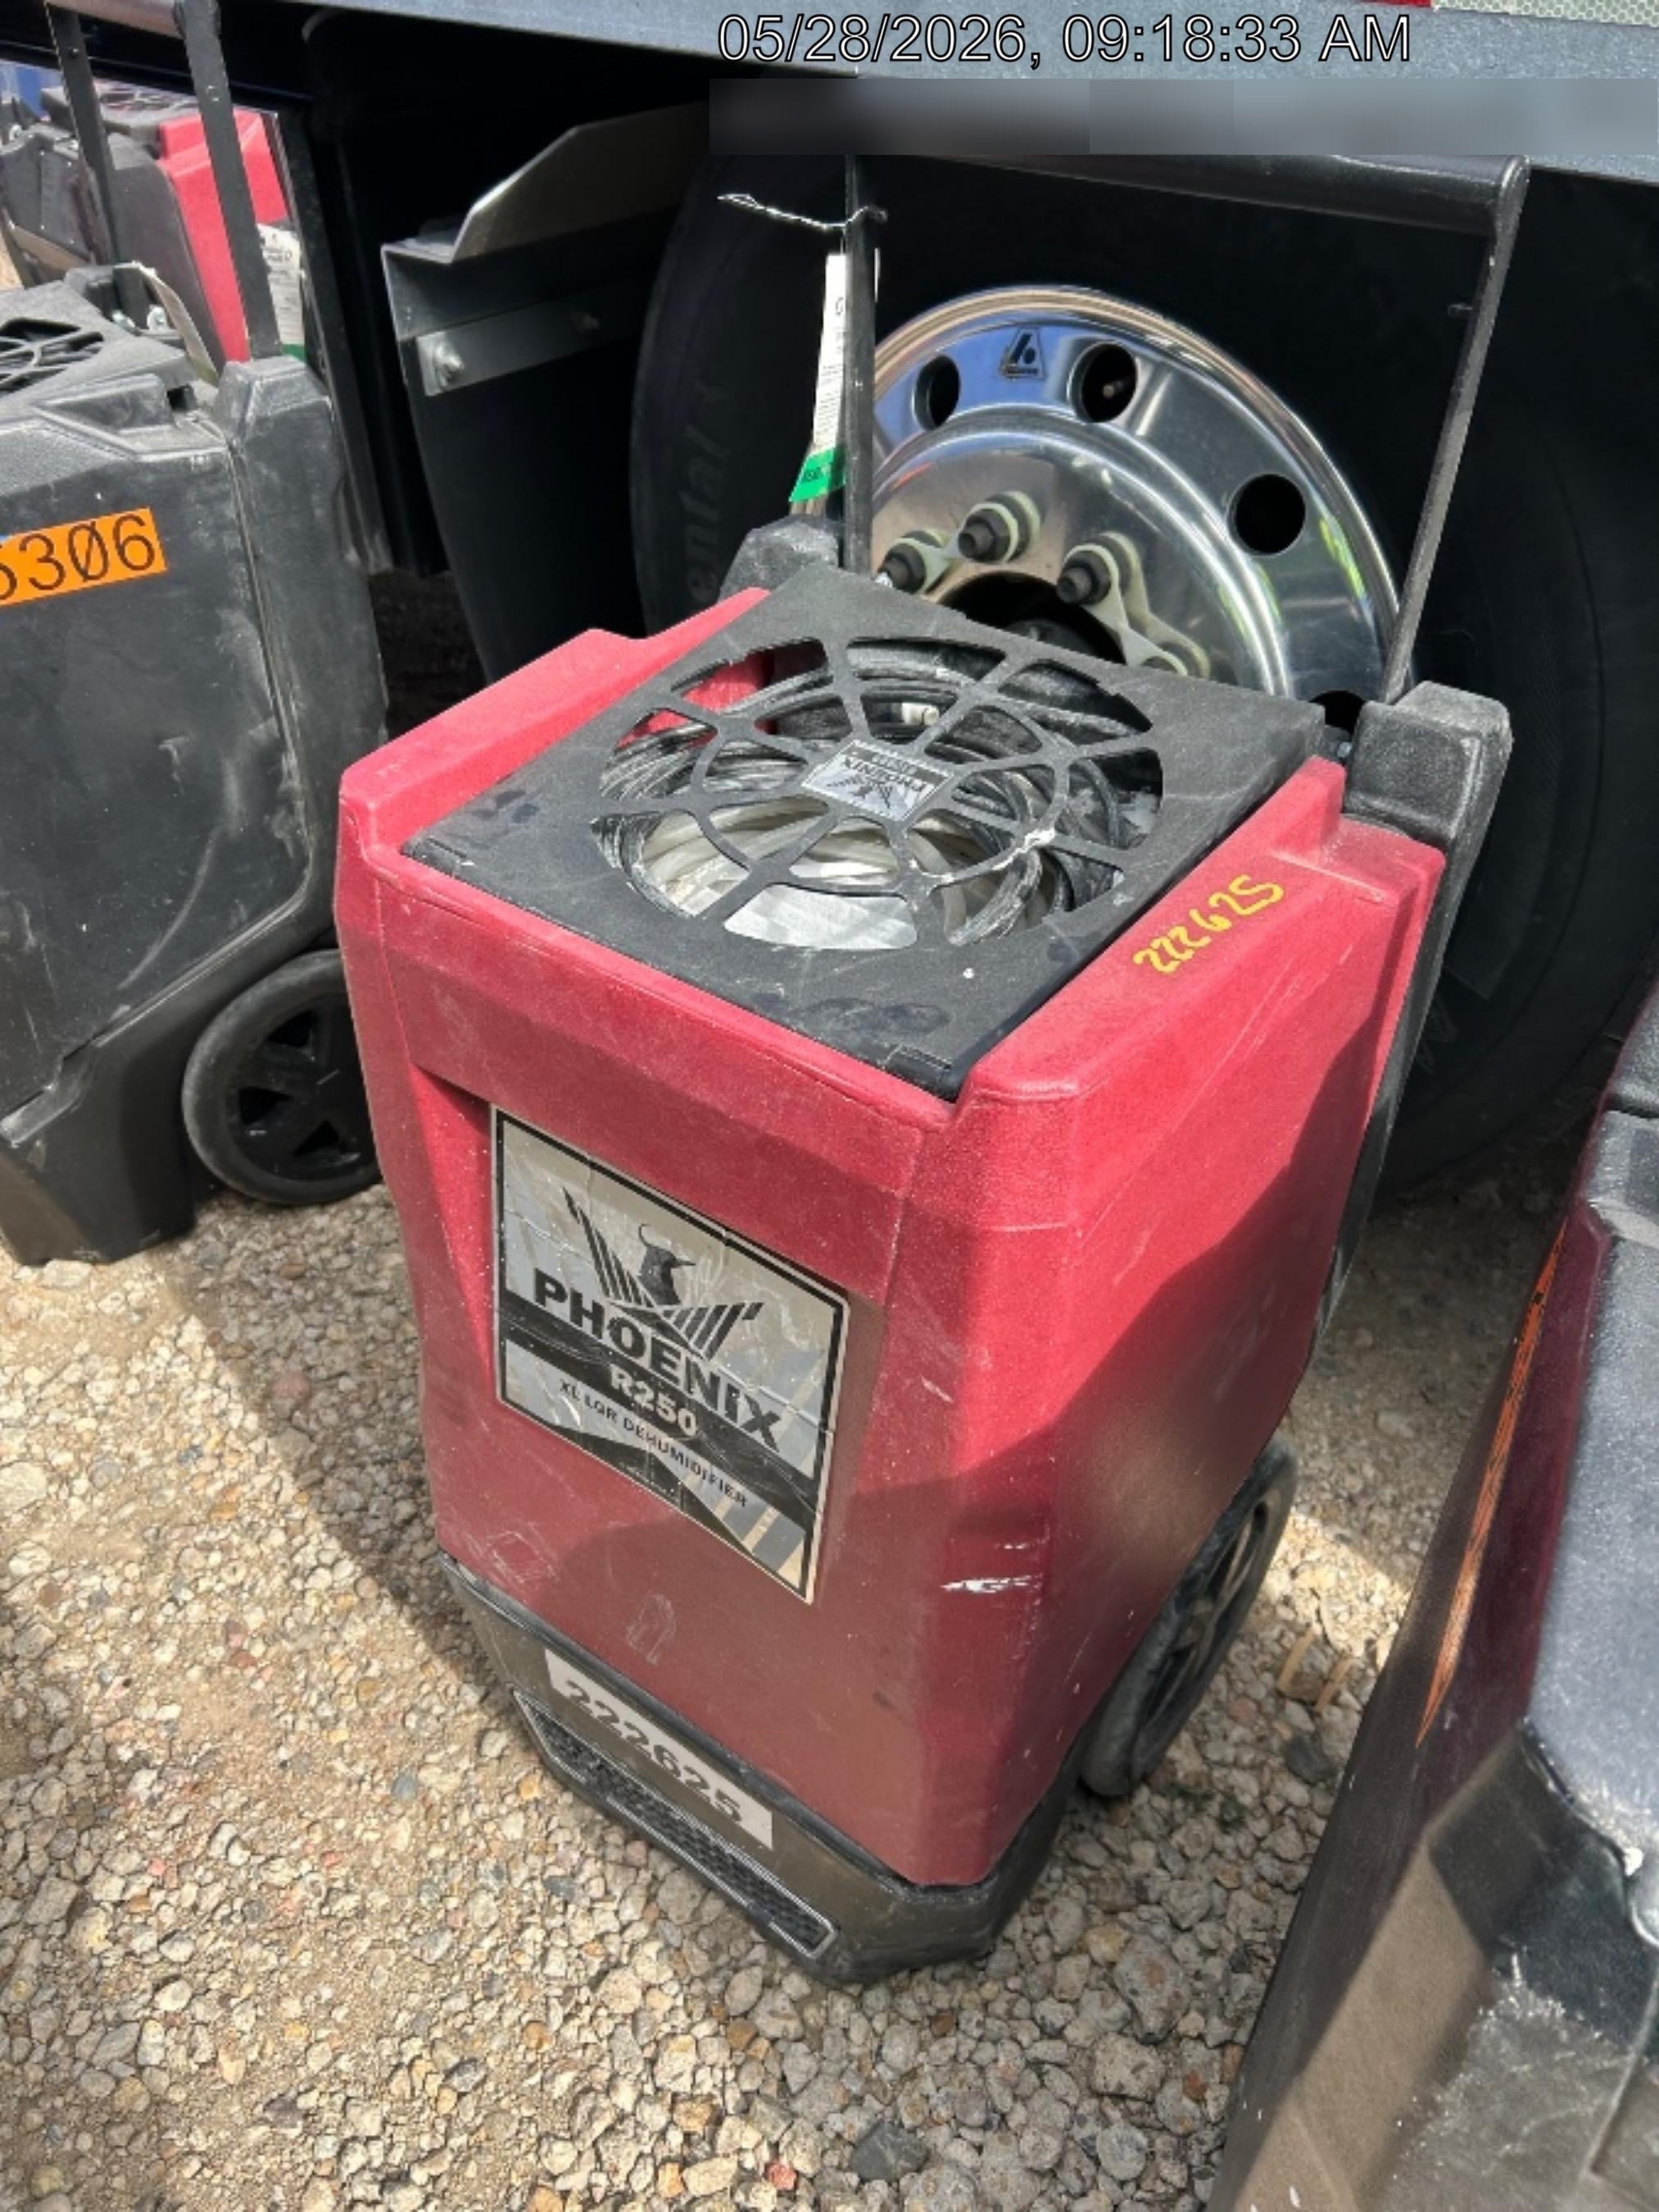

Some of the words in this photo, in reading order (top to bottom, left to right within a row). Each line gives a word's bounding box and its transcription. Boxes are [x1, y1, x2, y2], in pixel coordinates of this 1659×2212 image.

[534, 1267, 781, 1453] PHOENIX
[610, 1363, 699, 1437] R250
[584, 1393, 619, 1424] LGR
[623, 1416, 748, 1507] DEHUMIDIFIER
[564, 1679, 744, 1824] 222625
